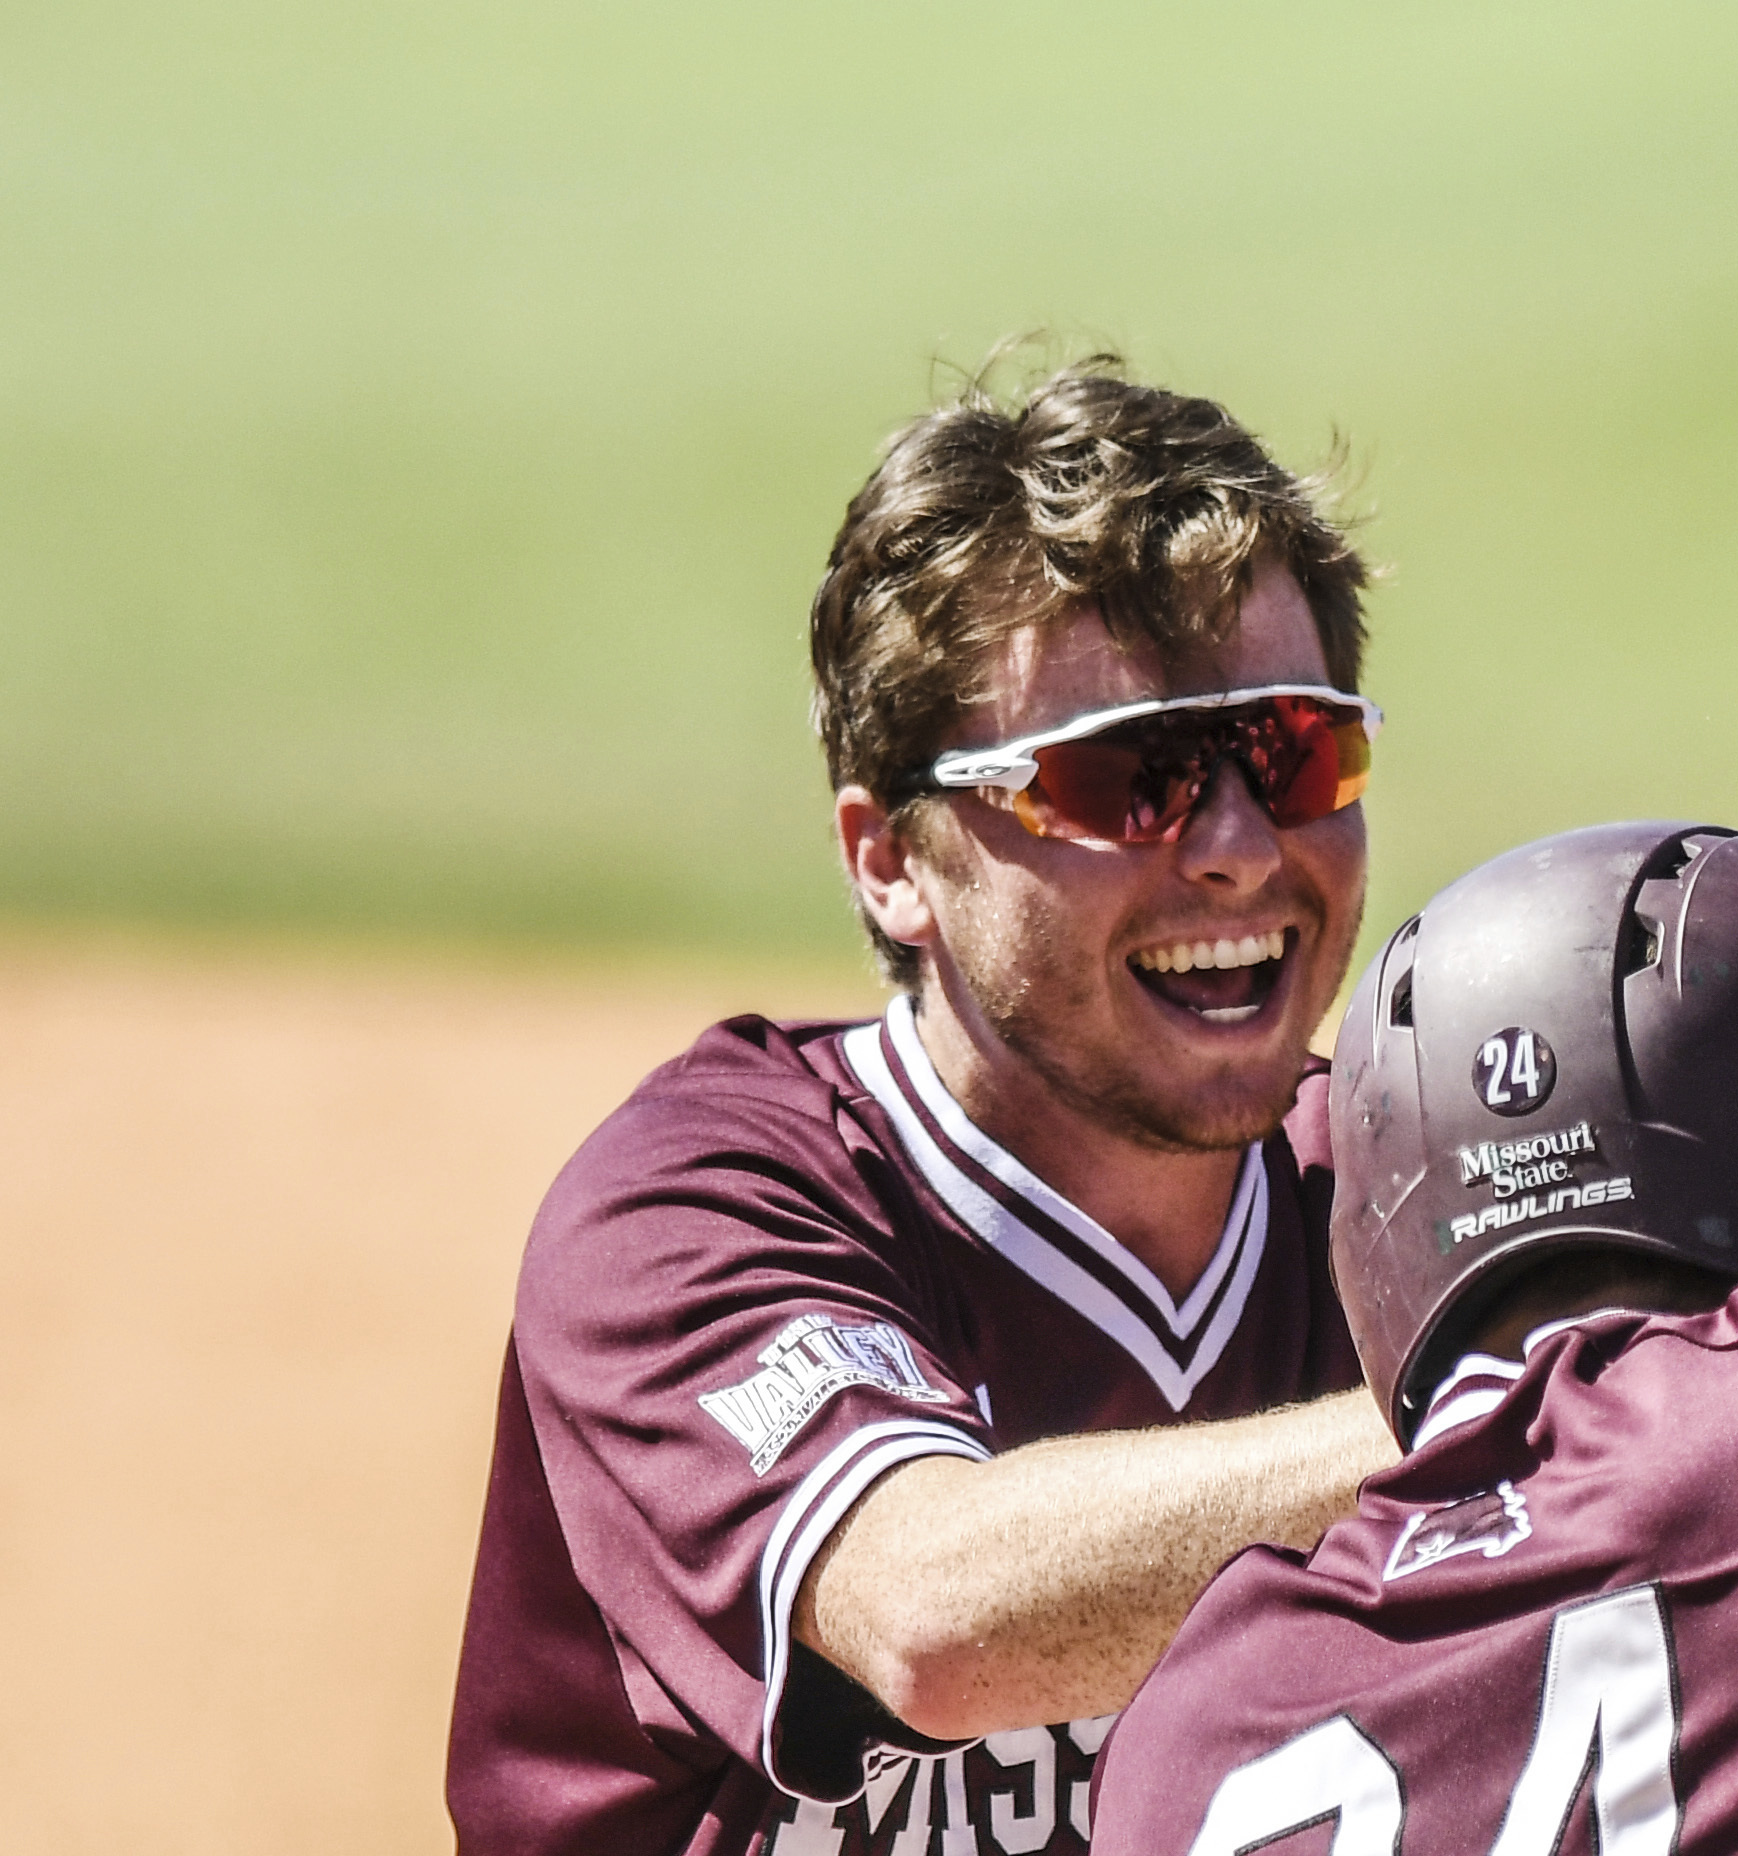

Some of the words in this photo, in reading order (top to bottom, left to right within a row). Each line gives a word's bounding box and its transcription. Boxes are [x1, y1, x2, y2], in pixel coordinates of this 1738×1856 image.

[1483, 1034, 1540, 1107] 24
[1459, 1121, 1596, 1185] Missouri
[1492, 1159, 1568, 1199] State
[1450, 1176, 1636, 1244] RAWLINGS
[698, 1321, 932, 1456] VALLEY
